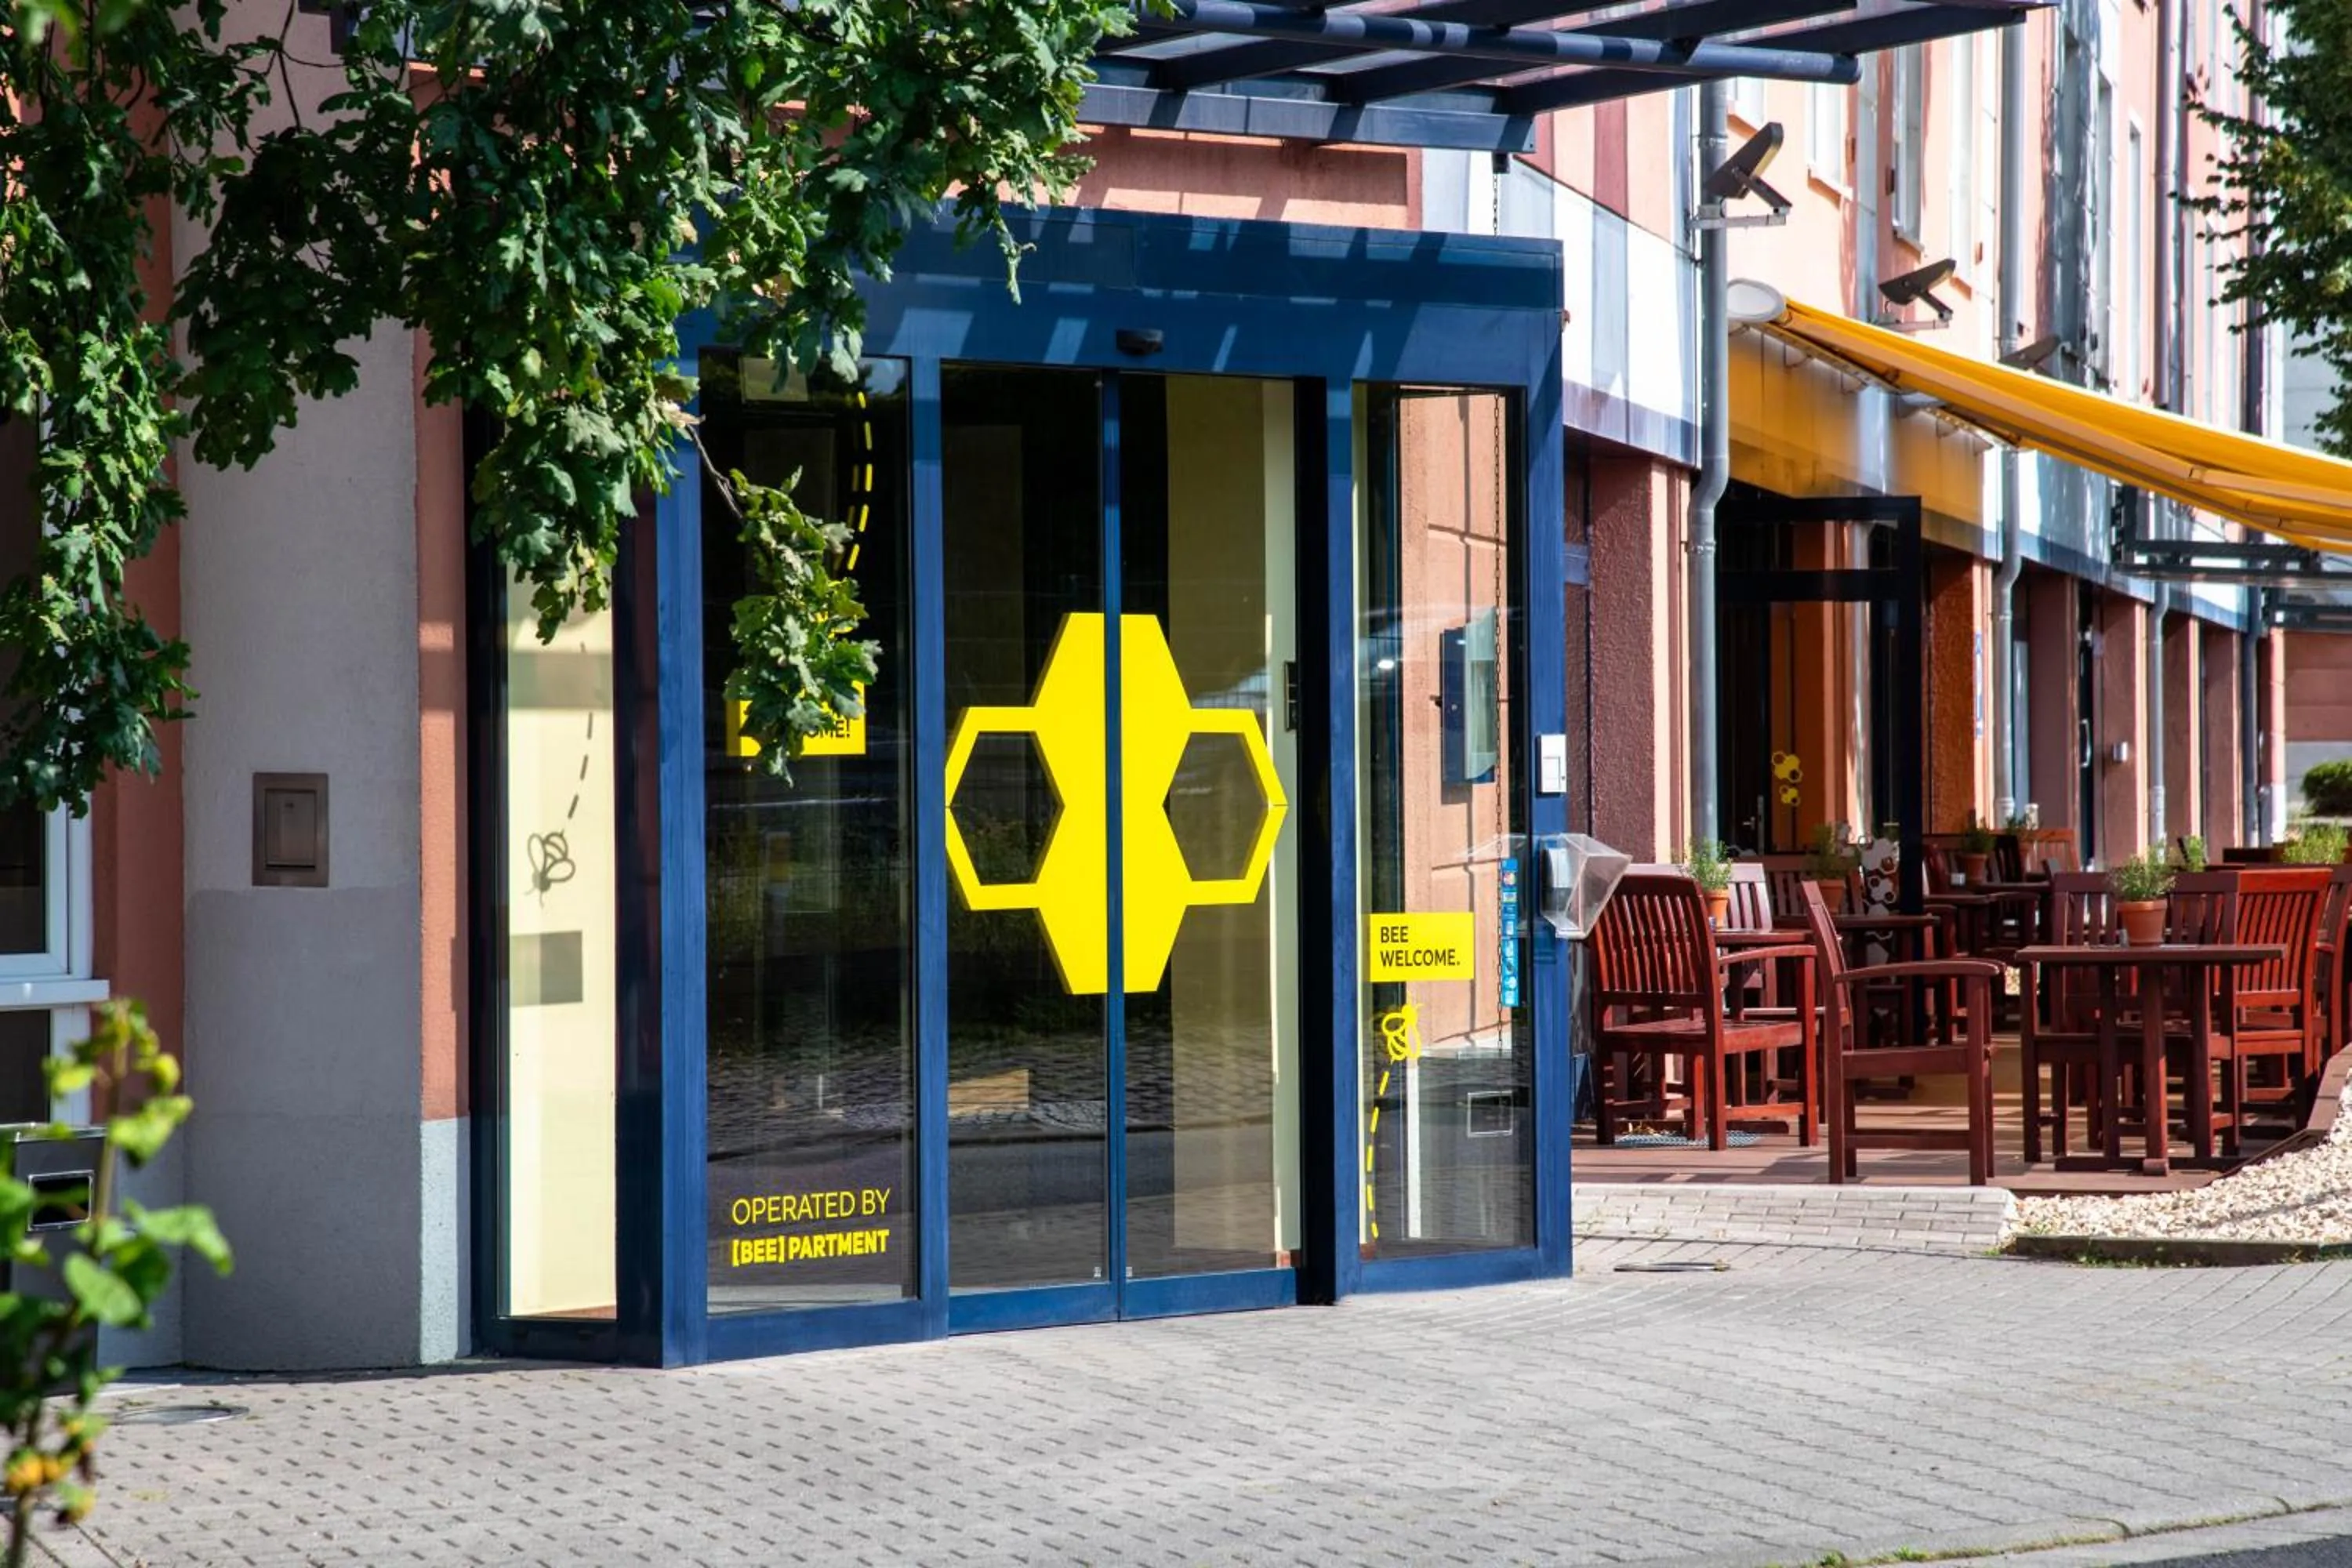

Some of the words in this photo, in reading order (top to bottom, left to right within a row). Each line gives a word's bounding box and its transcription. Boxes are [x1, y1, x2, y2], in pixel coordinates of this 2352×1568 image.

[1380, 926, 1409, 943] BEE
[1380, 949, 1461, 967] WELCOME.
[732, 1191, 856, 1225] OPERATED
[862, 1188, 891, 1215] BY
